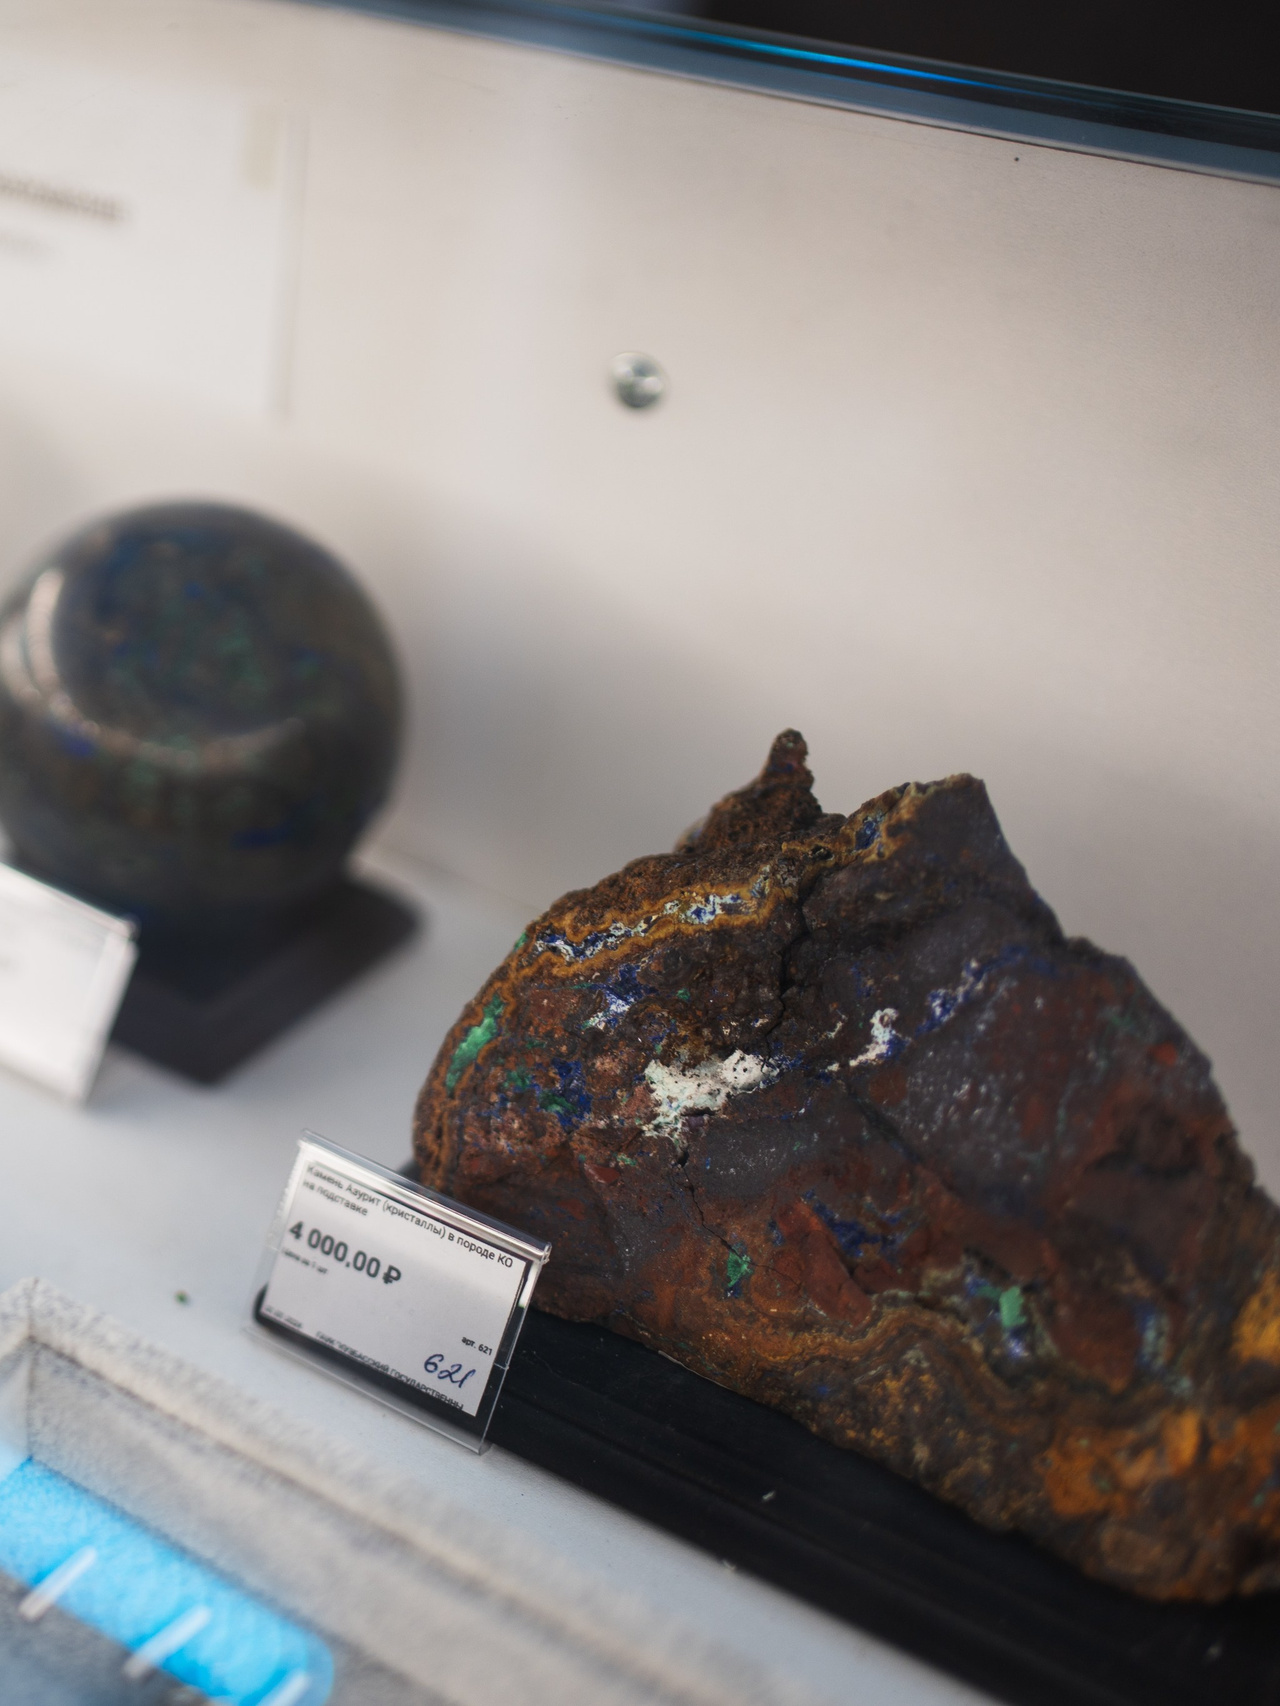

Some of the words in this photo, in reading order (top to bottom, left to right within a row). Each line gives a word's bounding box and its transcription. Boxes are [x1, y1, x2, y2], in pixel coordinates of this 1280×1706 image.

[302, 1179, 315, 1191] на
[316, 1184, 368, 1216] подставке
[306, 1165, 344, 1189] Камень
[345, 1183, 381, 1207] Азурит
[382, 1199, 446, 1240] (кристаллы)
[448, 1232, 456, 1242] в
[456, 1238, 495, 1260] породе
[497, 1255, 513, 1269] КО
[461, 1336, 477, 1349] арт.
[478, 1343, 493, 1356] 621
[424, 1353, 477, 1388] 621
